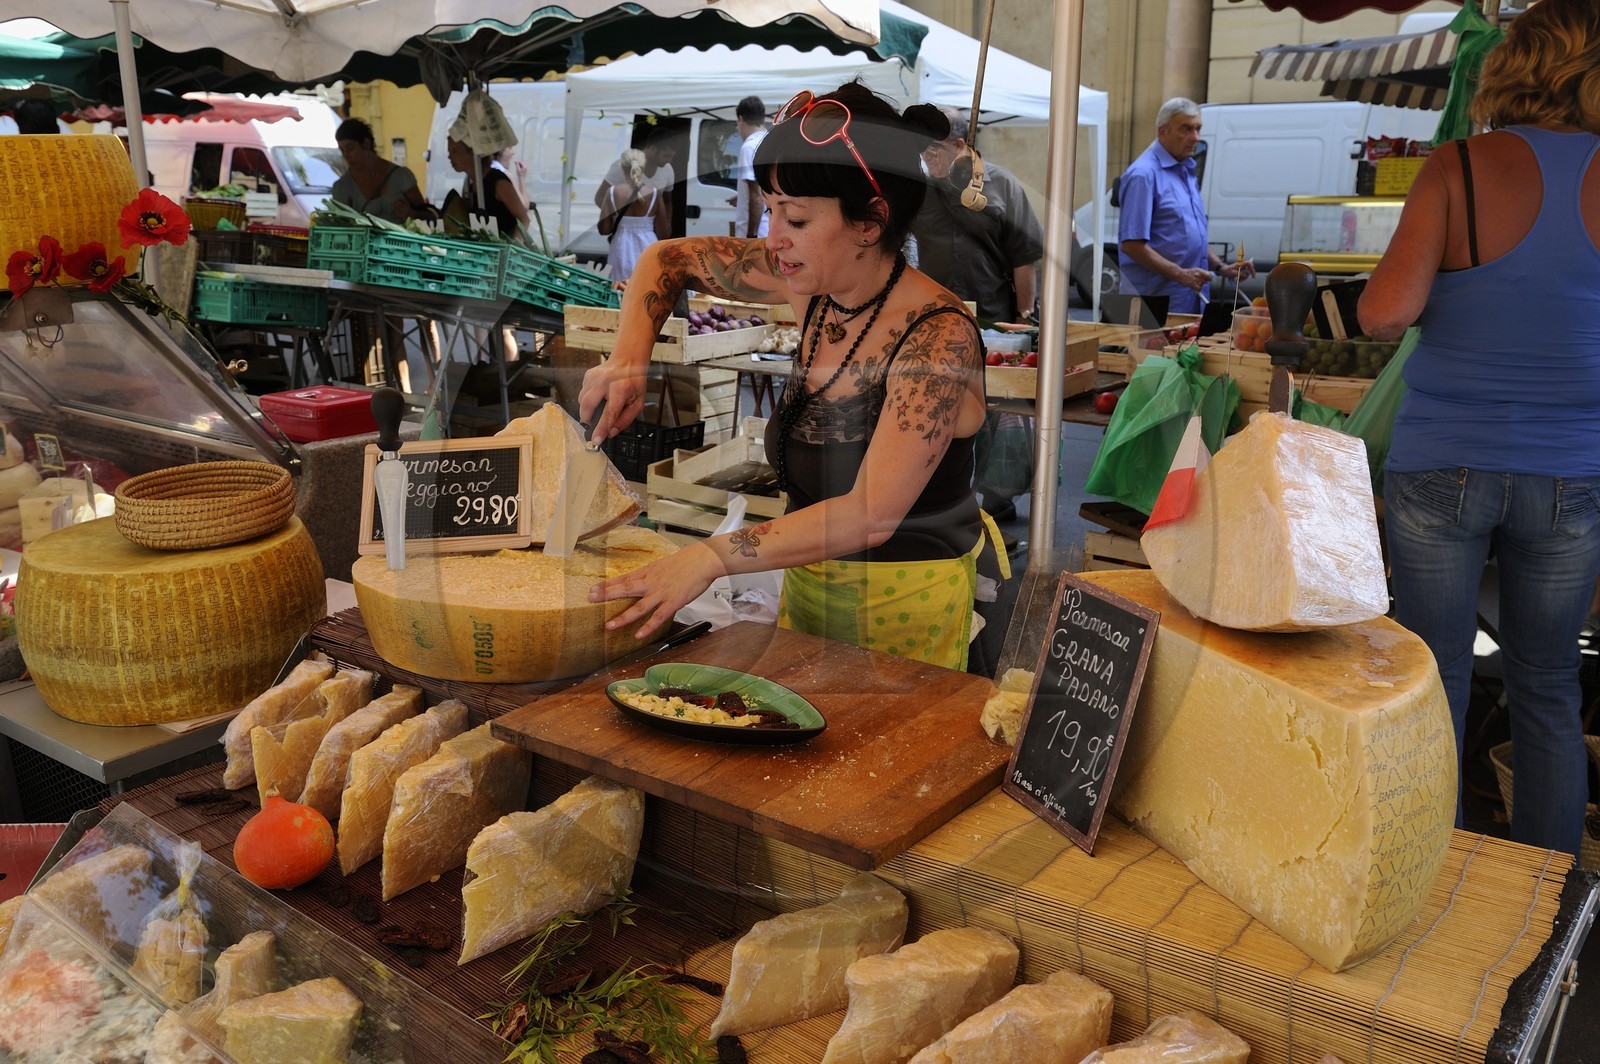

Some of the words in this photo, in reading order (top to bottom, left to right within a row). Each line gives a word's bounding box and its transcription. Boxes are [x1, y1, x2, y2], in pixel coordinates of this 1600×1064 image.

[385, 454, 495, 475] armesan
[405, 474, 498, 509] eggiano
[1051, 628, 1114, 685] GRANA
[1058, 661, 1120, 719] PADANO
[1380, 839, 1414, 862] GRANA
